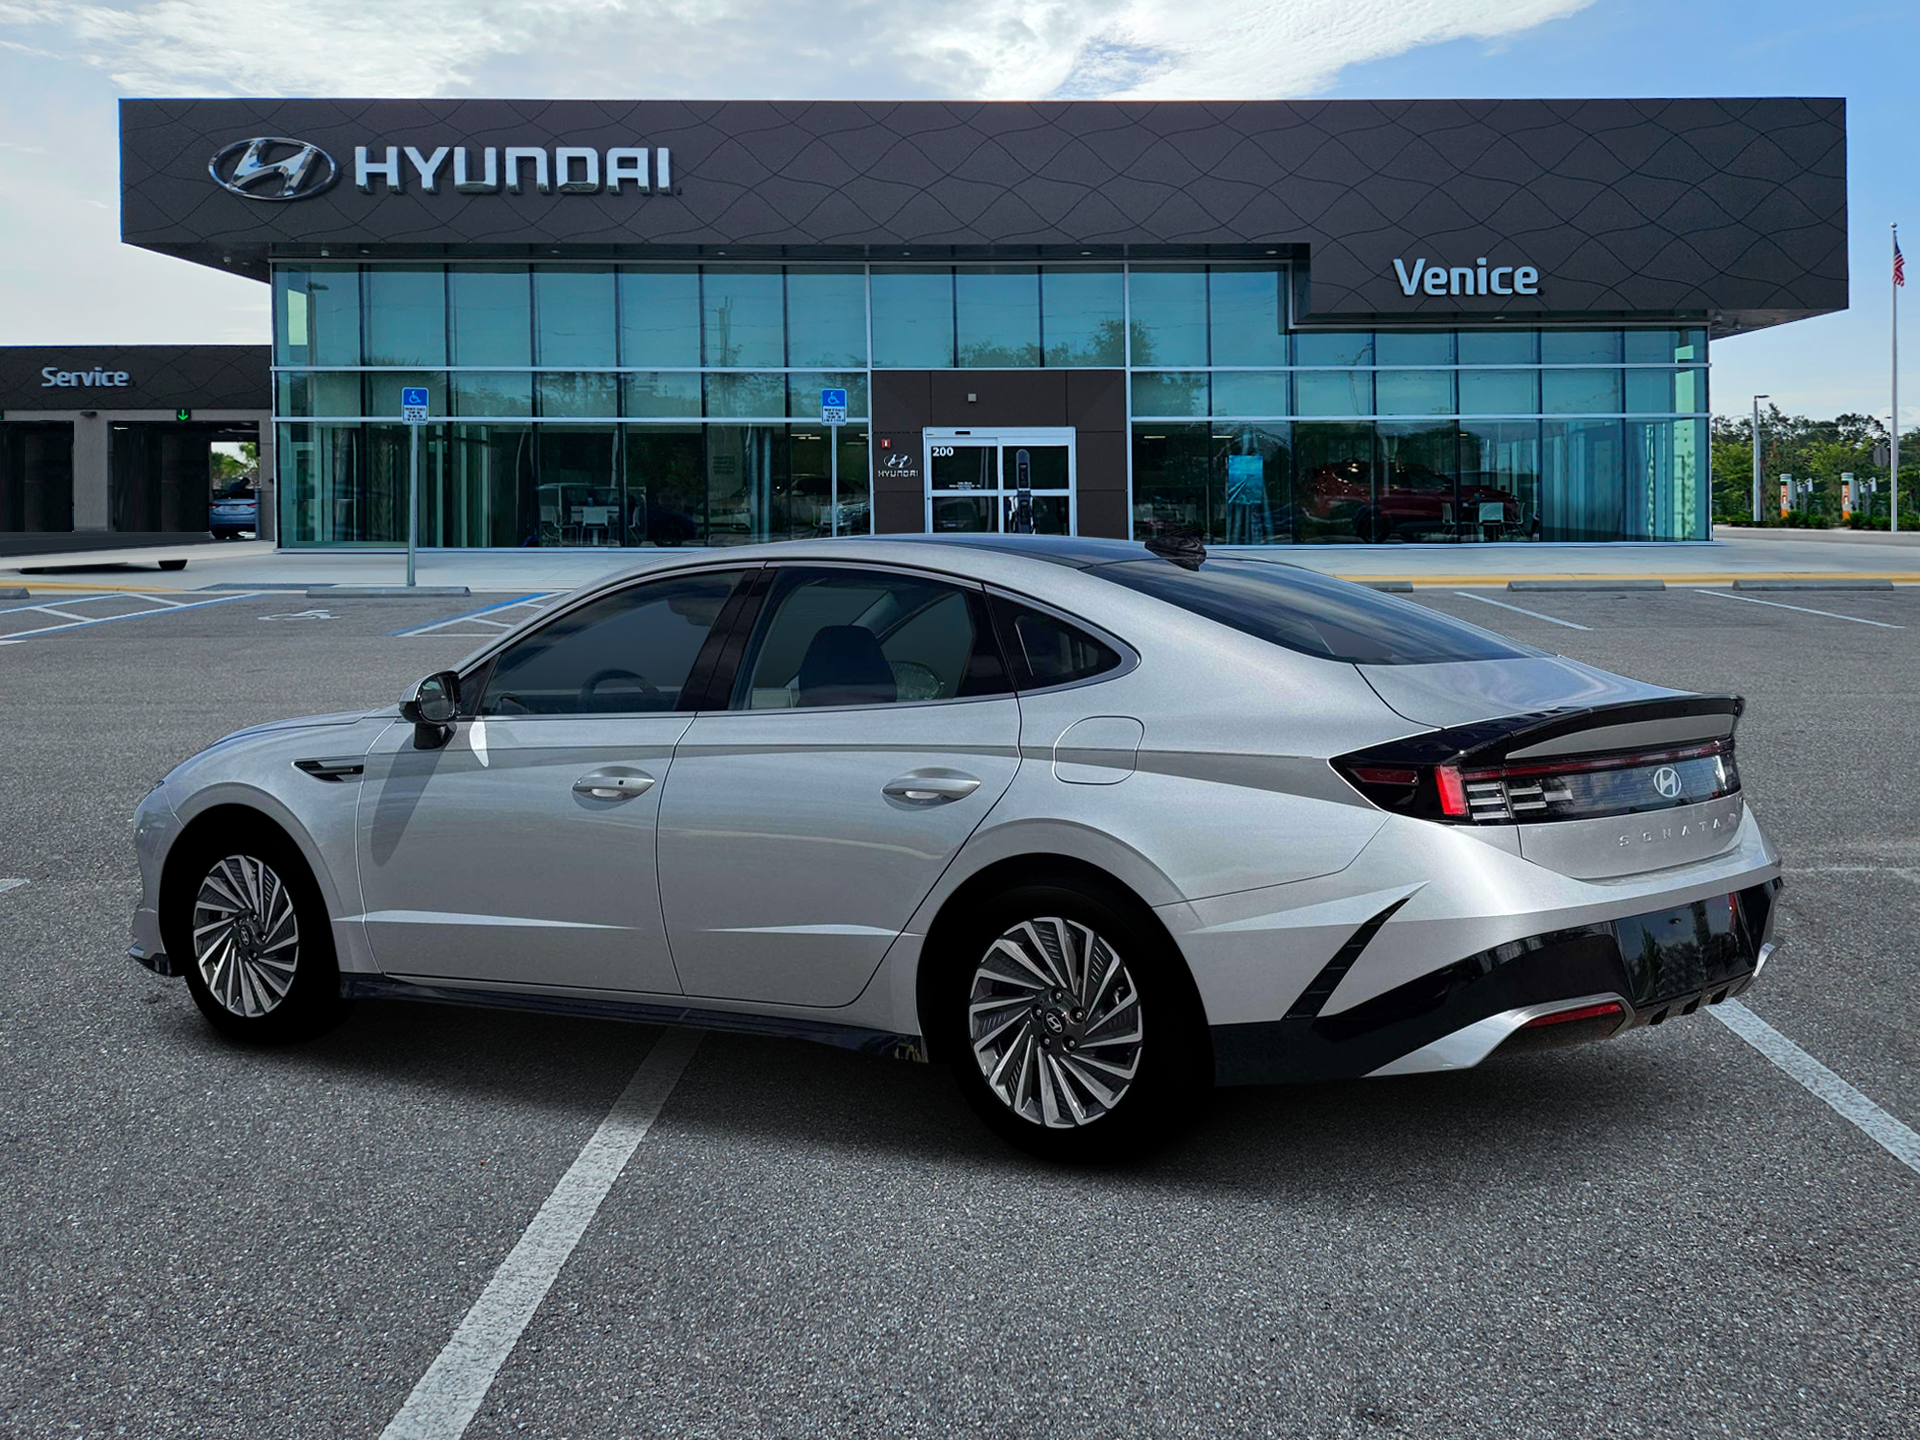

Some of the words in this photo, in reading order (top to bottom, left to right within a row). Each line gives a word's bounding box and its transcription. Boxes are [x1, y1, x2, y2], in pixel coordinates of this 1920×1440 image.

[355, 146, 672, 193] HYUNDAI
[1392, 257, 1539, 296] Venice
[41, 366, 130, 387] Service
[932, 446, 954, 457] 200
[877, 469, 919, 478] HYUNDAI
[1619, 818, 1721, 847] SONATA
